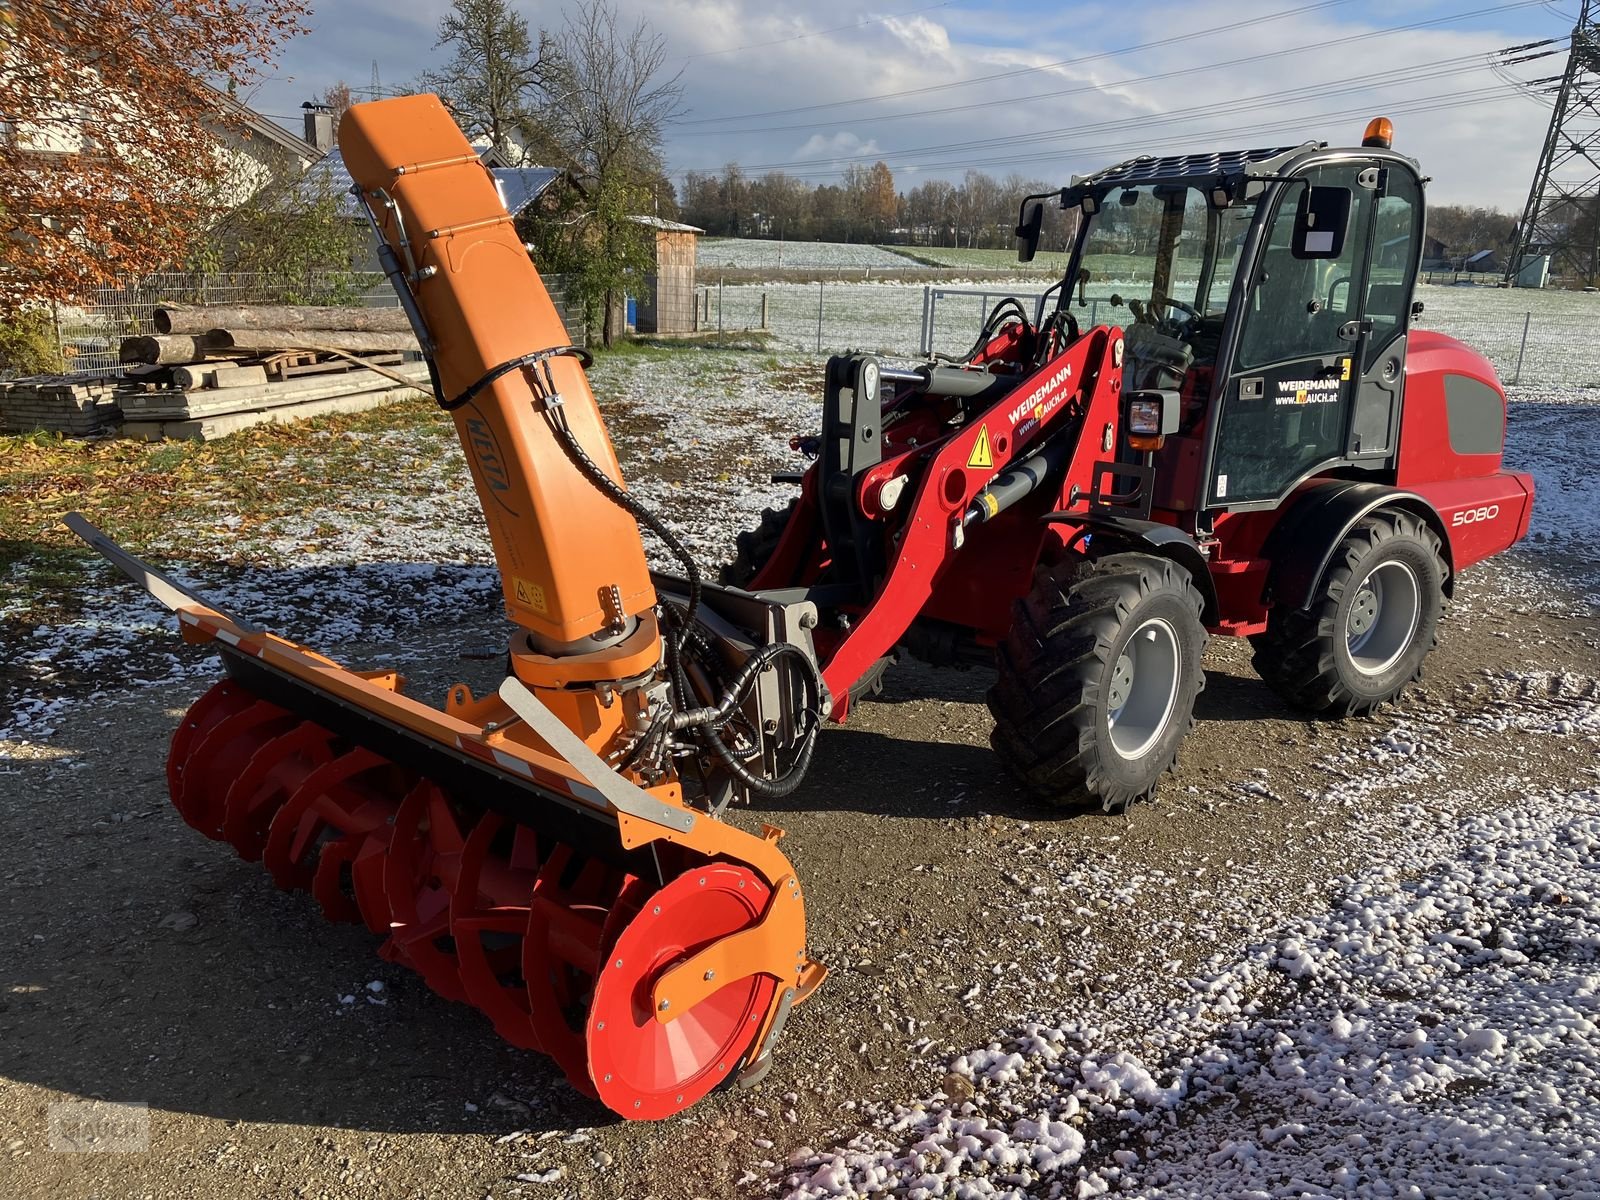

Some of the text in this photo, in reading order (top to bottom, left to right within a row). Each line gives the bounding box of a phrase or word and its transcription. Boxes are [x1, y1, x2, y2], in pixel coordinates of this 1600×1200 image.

[1008, 364, 1071, 425] WEIDEMANN
[1278, 379, 1339, 392] WEIDEMANN
[1275, 392, 1338, 406] www.MAUCH.at
[466, 418, 508, 490] WESTA
[1451, 505, 1499, 527] 5080
